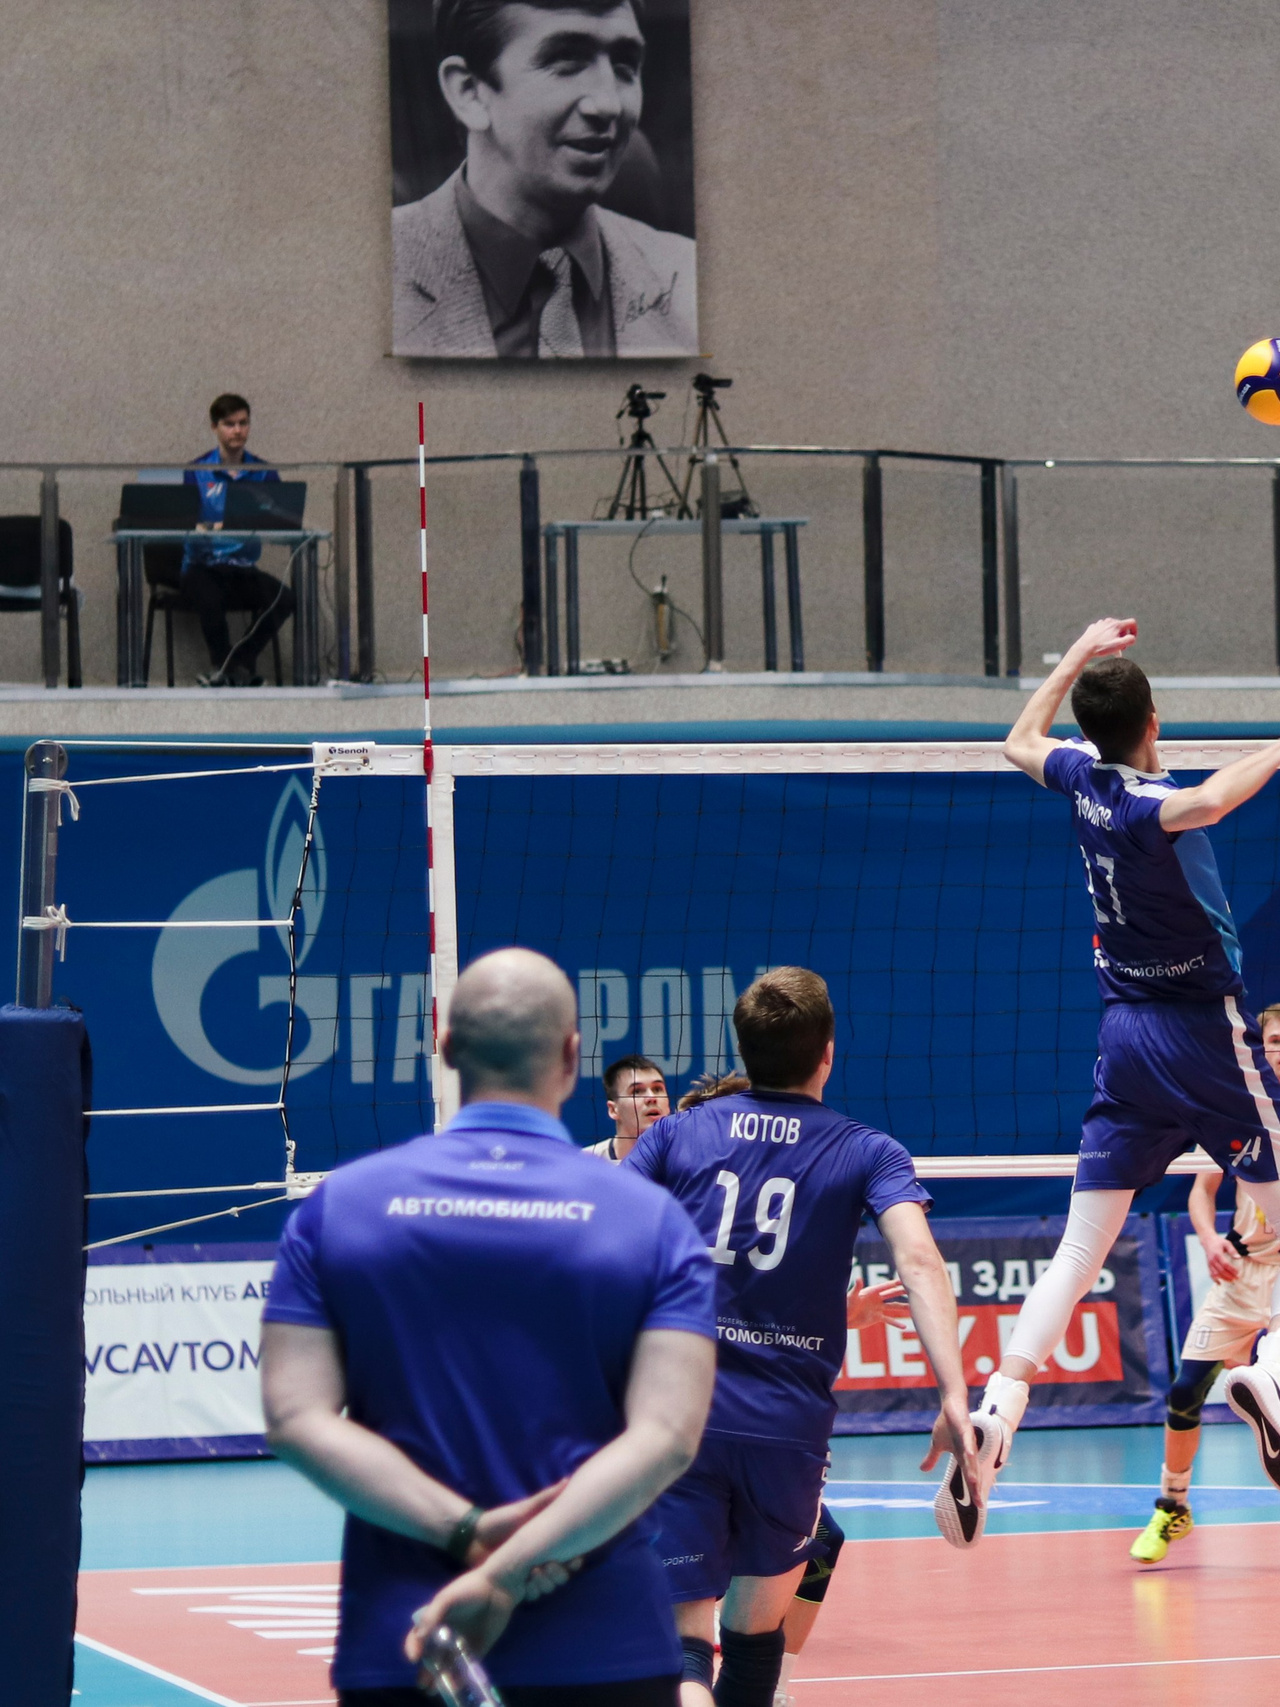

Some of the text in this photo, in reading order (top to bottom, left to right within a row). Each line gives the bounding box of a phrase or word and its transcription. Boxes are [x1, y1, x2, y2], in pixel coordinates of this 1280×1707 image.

[338, 747, 369, 755] Senoh
[730, 1112, 801, 1144] КОТОВ
[387, 1196, 596, 1222] АВТОМОБИЛИСТ
[706, 1169, 796, 1271] 19
[181, 1284, 237, 1300] КЛУБ
[662, 1553, 705, 1568] SPORTART
